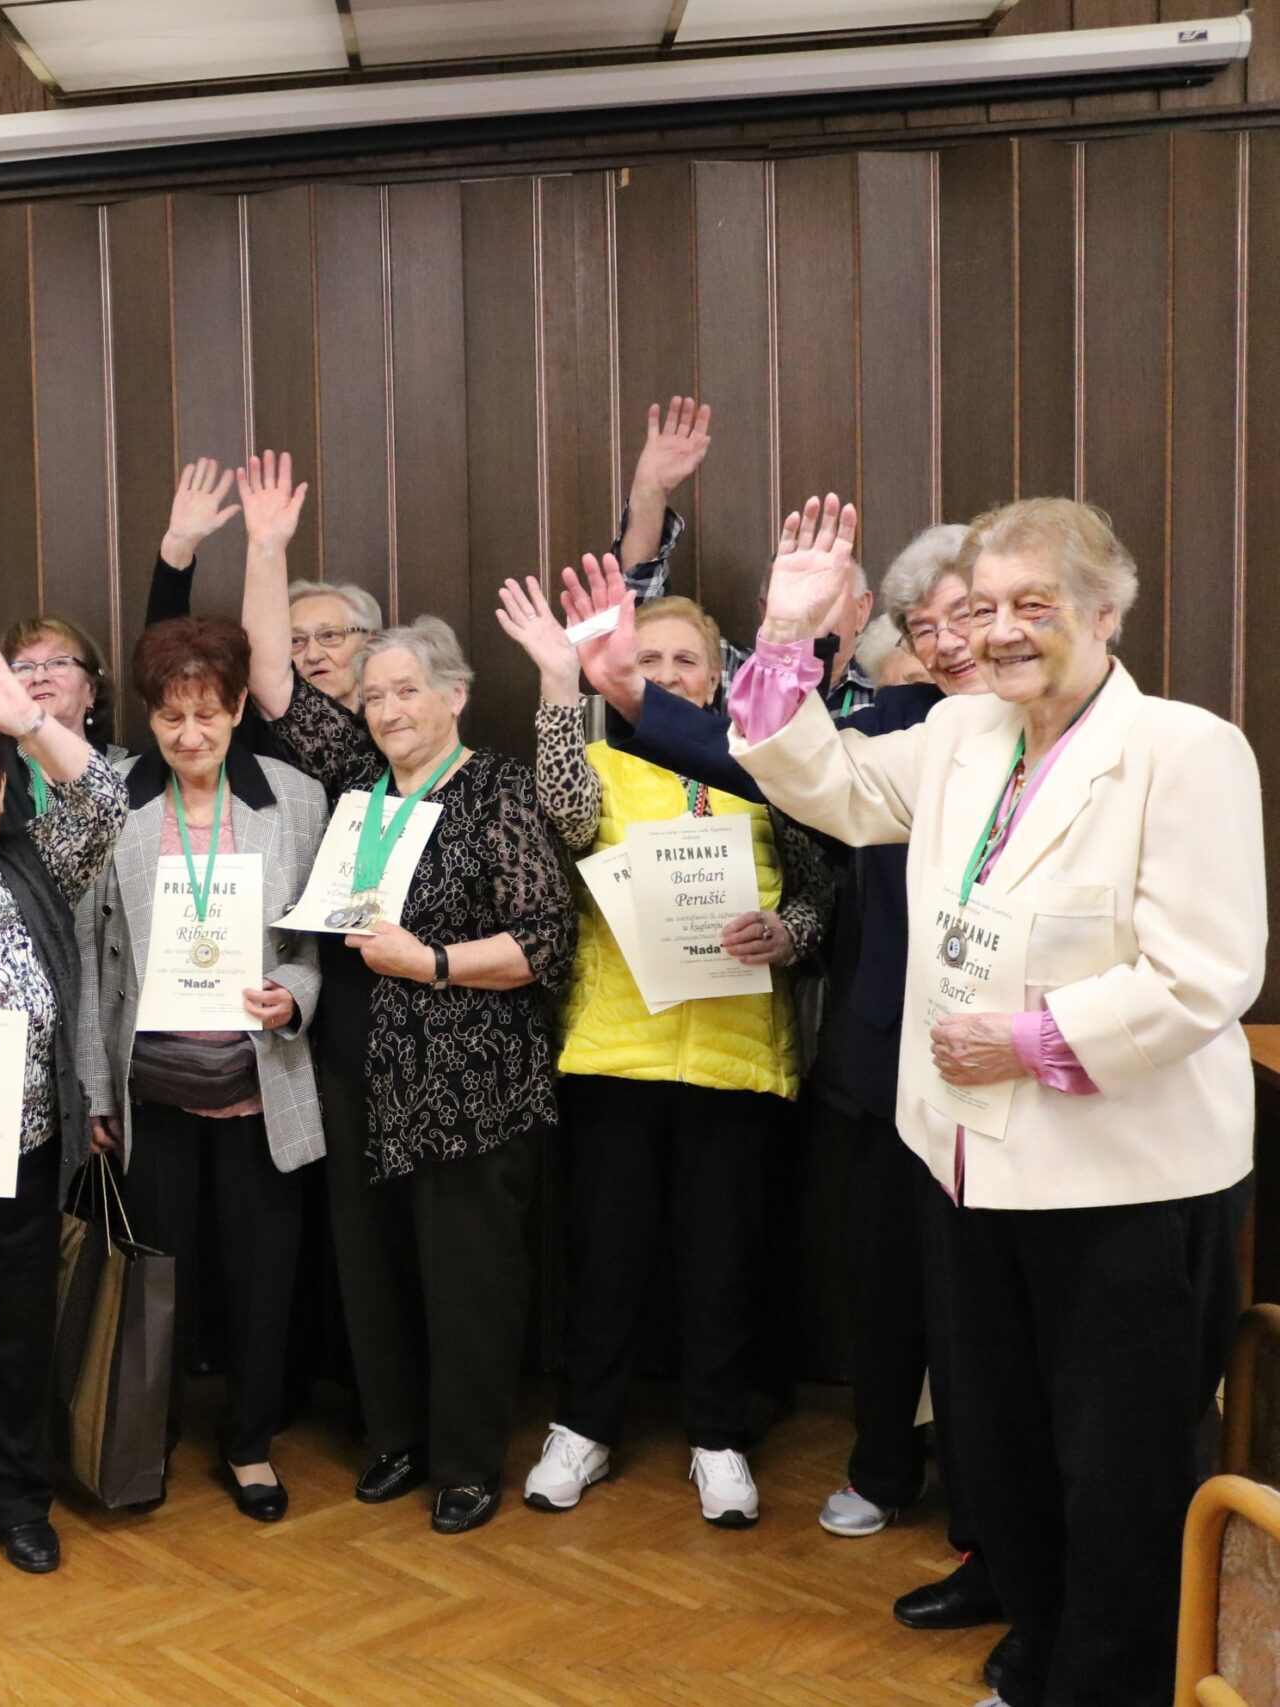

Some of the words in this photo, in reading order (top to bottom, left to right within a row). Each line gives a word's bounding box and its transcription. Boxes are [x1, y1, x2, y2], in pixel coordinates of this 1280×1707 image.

[656, 845, 729, 862] PRIZNANJE
[670, 867, 725, 885] Barbari
[164, 882, 237, 895] PRIZNJE
[675, 890, 727, 907] Perušić
[183, 903, 222, 922] Ljbi
[177, 978, 221, 990] "Nada"
[939, 977, 976, 1006] Barić
